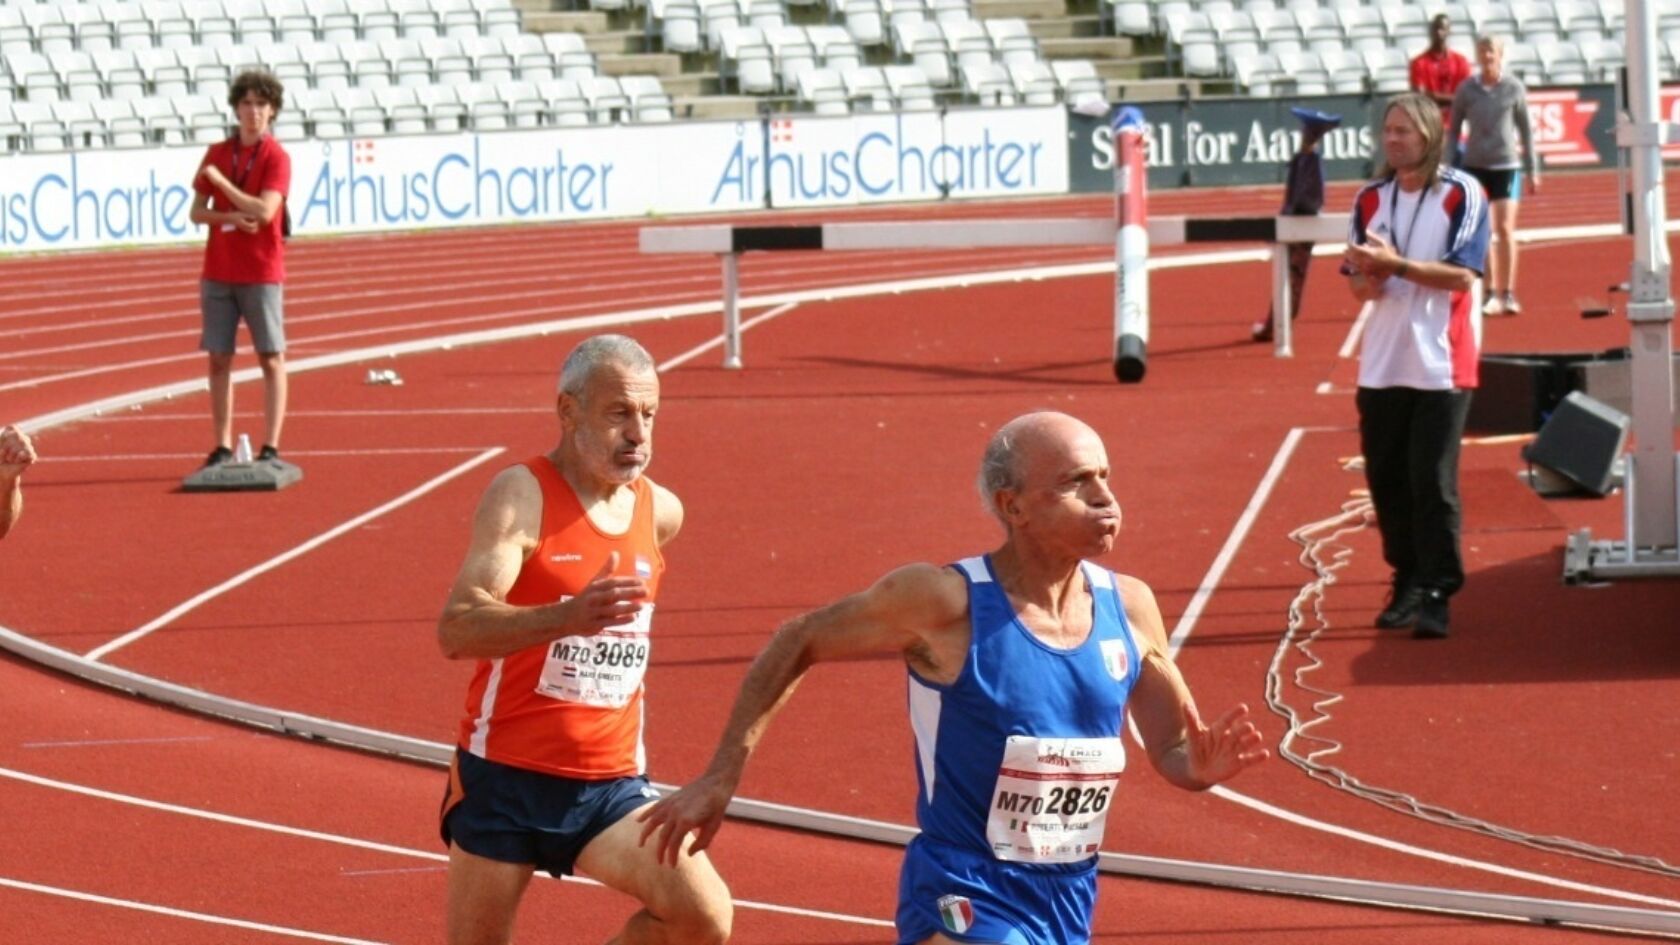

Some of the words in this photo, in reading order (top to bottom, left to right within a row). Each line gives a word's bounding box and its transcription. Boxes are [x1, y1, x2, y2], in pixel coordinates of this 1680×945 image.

[711, 109, 1042, 204] ÅrhusCharter
[1091, 122, 1174, 170] Sål
[1186, 120, 1237, 165] for
[301, 135, 613, 227] ÅrhusCharter
[552, 642, 591, 664] M70
[592, 641, 646, 668] 3089
[997, 791, 1044, 815] M70
[1045, 786, 1110, 816] 2826
